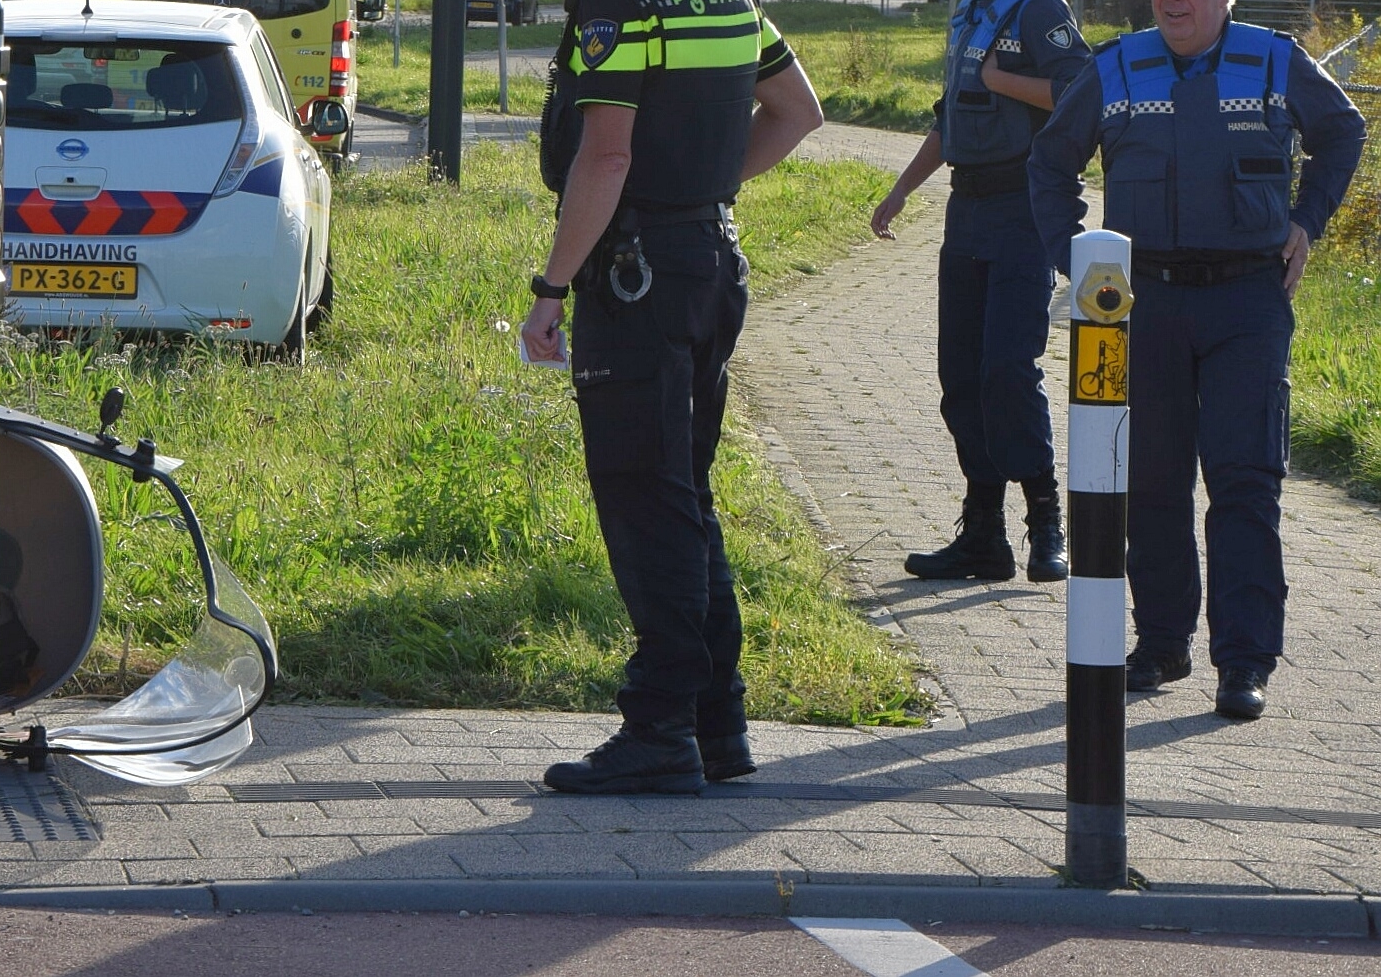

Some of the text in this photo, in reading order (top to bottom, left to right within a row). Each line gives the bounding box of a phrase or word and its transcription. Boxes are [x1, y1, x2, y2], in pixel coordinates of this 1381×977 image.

[584, 25, 614, 37] POLITIE
[3, 242, 137, 262] HANDHAVING
[20, 267, 126, 291] PX-362-G
